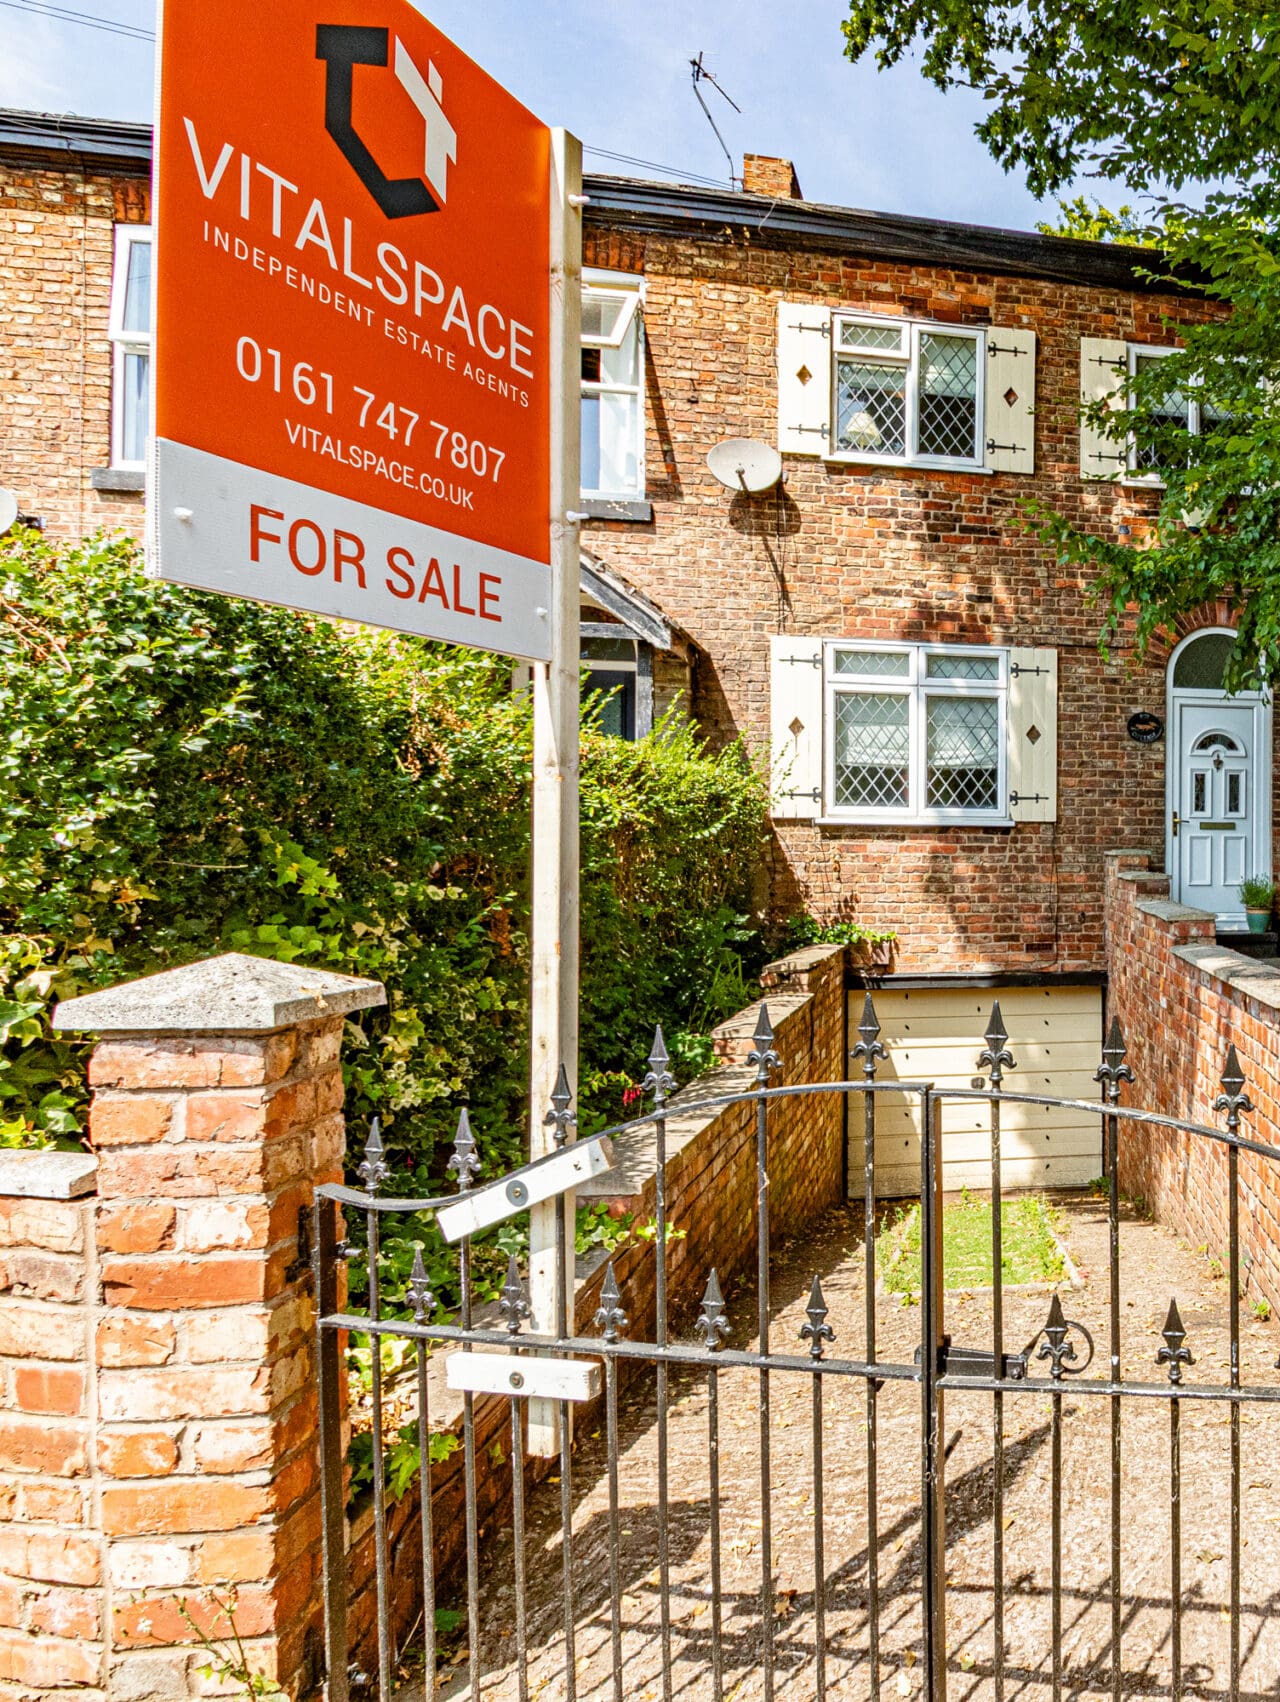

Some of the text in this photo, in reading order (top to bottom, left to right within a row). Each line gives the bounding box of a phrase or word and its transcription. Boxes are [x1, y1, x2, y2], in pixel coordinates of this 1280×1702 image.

[183, 116, 534, 379] VITALSPACE
[203, 221, 530, 408] INDEPENDENT ESTATE AGENTS
[236, 336, 506, 482] 0161 747 7807
[285, 419, 474, 511] VITALSPACE.CO.UK
[249, 503, 503, 623] FOR SALE
